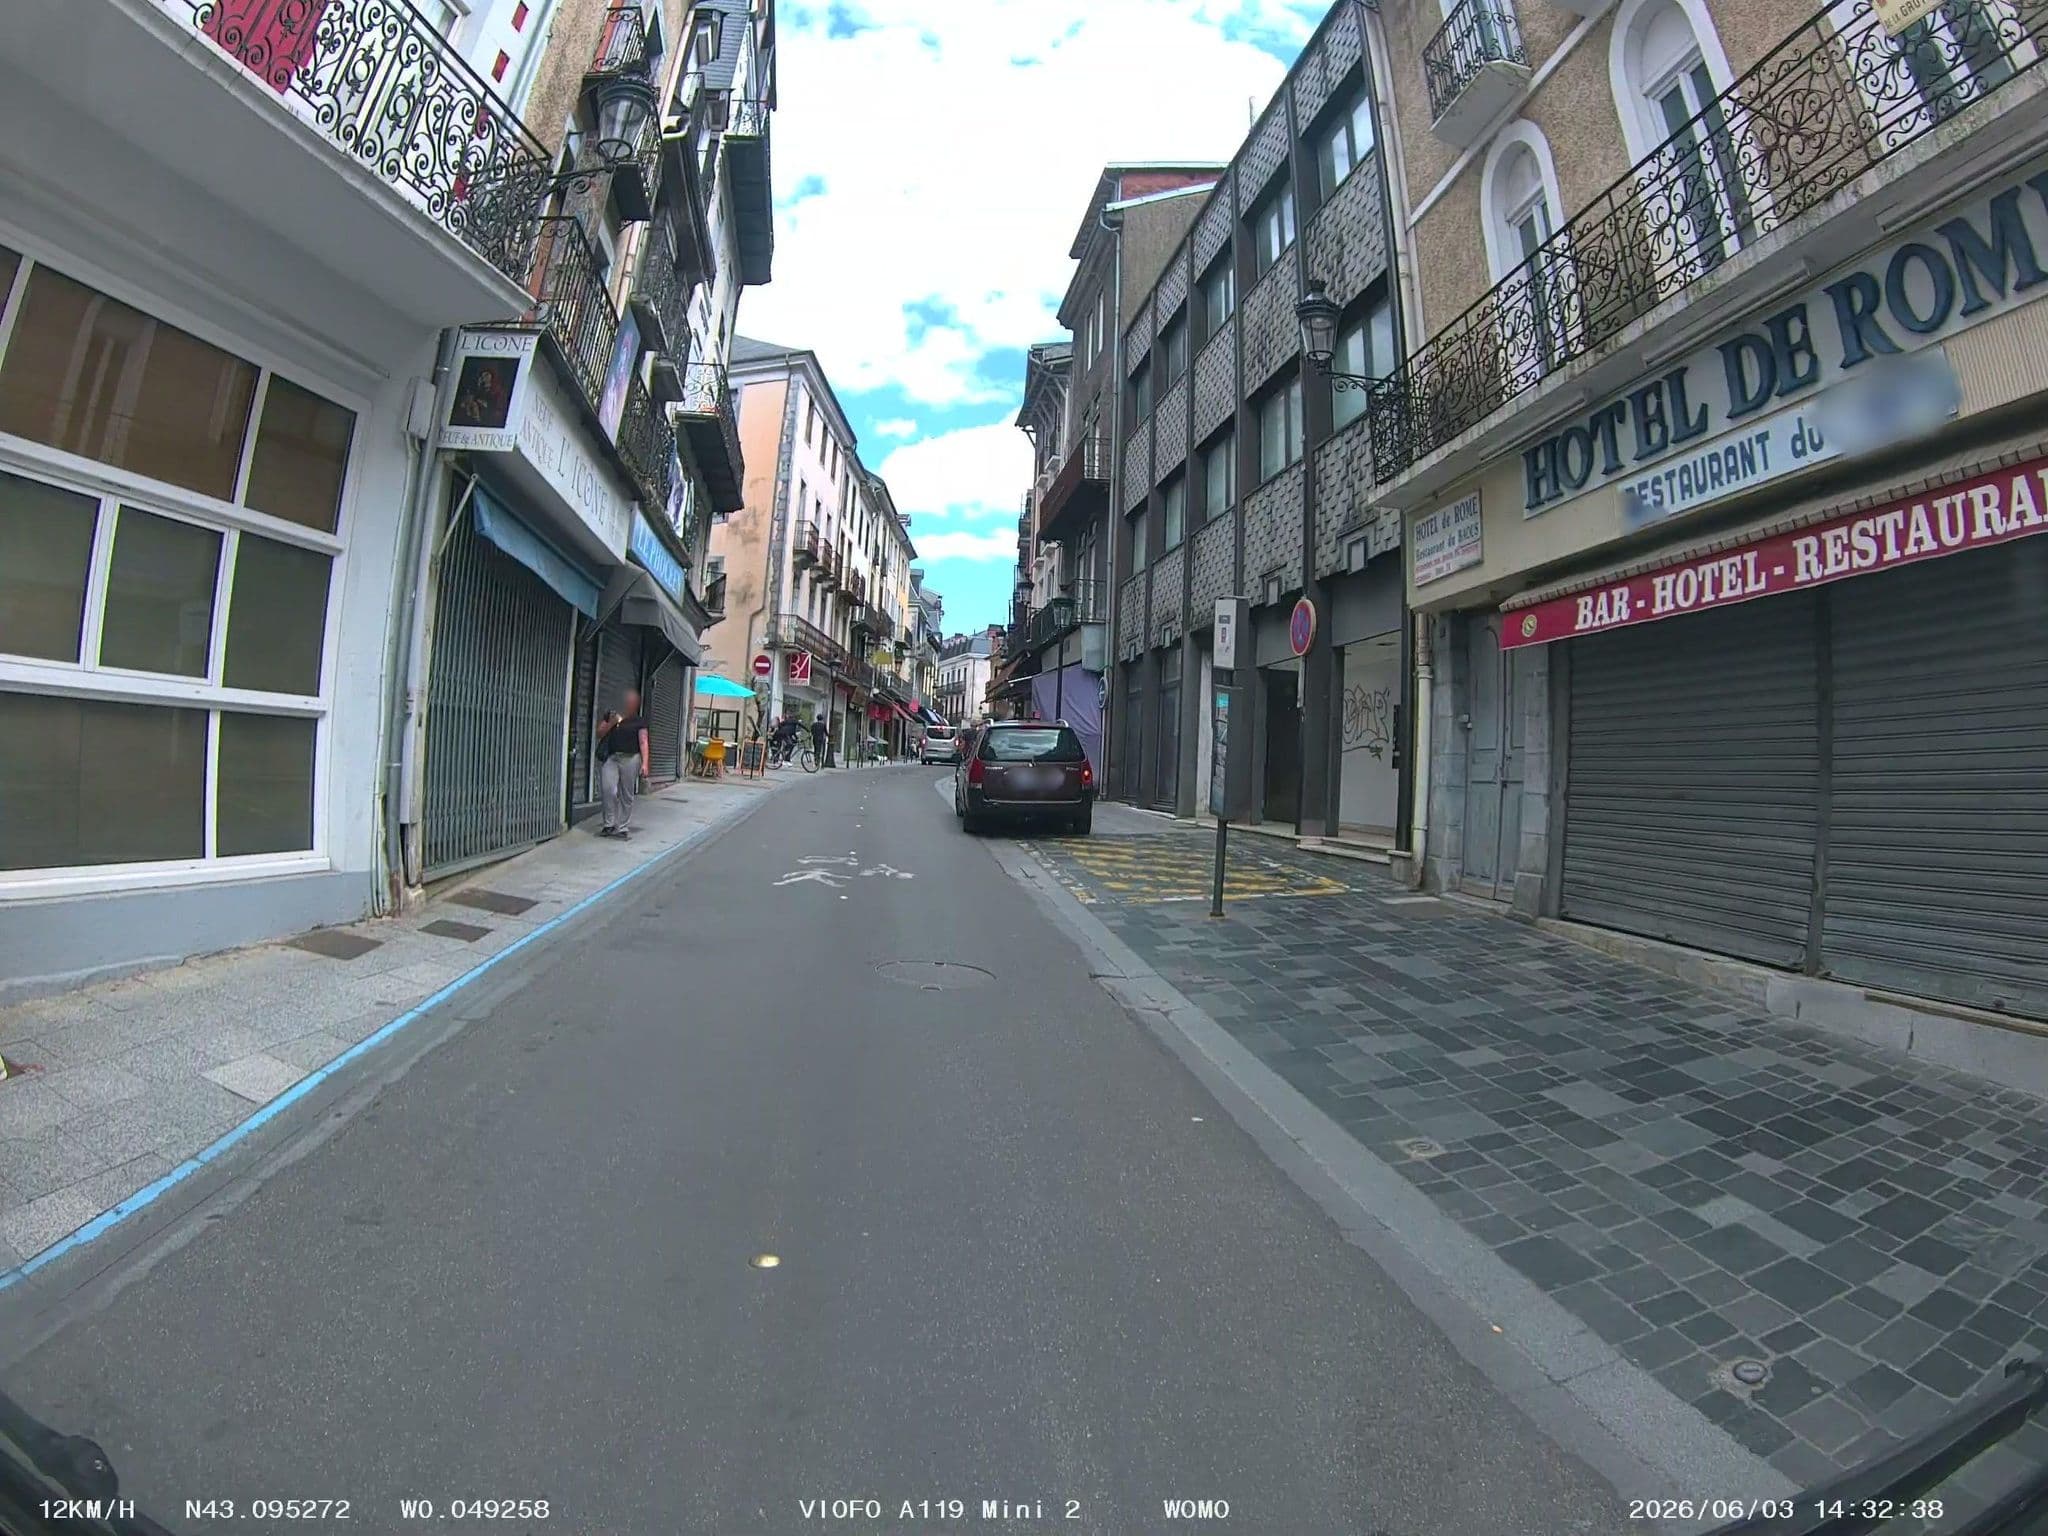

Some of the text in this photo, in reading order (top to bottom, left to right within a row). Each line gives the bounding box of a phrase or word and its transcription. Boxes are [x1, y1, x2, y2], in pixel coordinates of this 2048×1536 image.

[1521, 366, 1708, 509] HOTEL
[1714, 302, 1820, 421] DE
[1574, 587, 1630, 631] BAR
[1651, 550, 1766, 615] HOTEL
